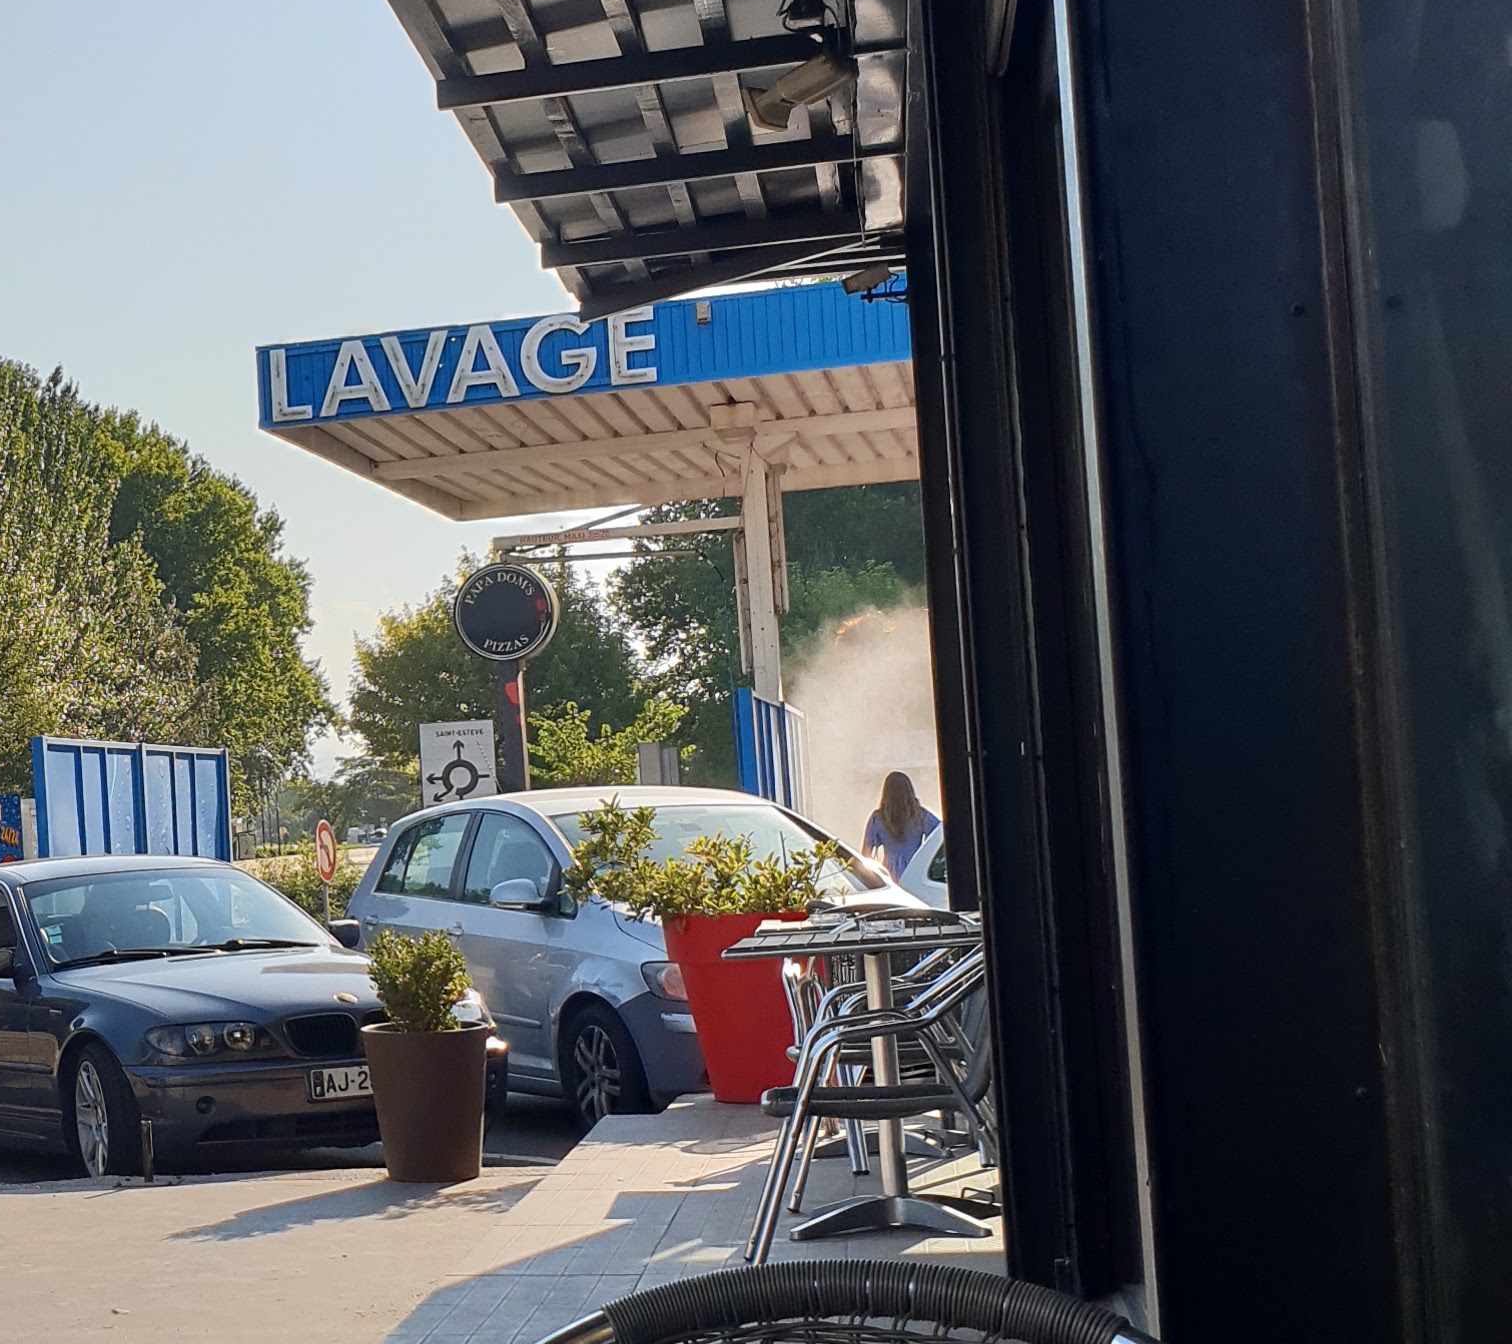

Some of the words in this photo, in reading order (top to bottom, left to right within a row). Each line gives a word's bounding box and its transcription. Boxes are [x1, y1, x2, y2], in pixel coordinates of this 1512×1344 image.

[269, 305, 657, 422] LAVAGE
[519, 535, 561, 545] HAUTEUR
[564, 532, 585, 542] MAXI
[465, 576, 494, 605] PAPA
[497, 572, 535, 596] DOM'S
[483, 635, 529, 652] PIZZAS
